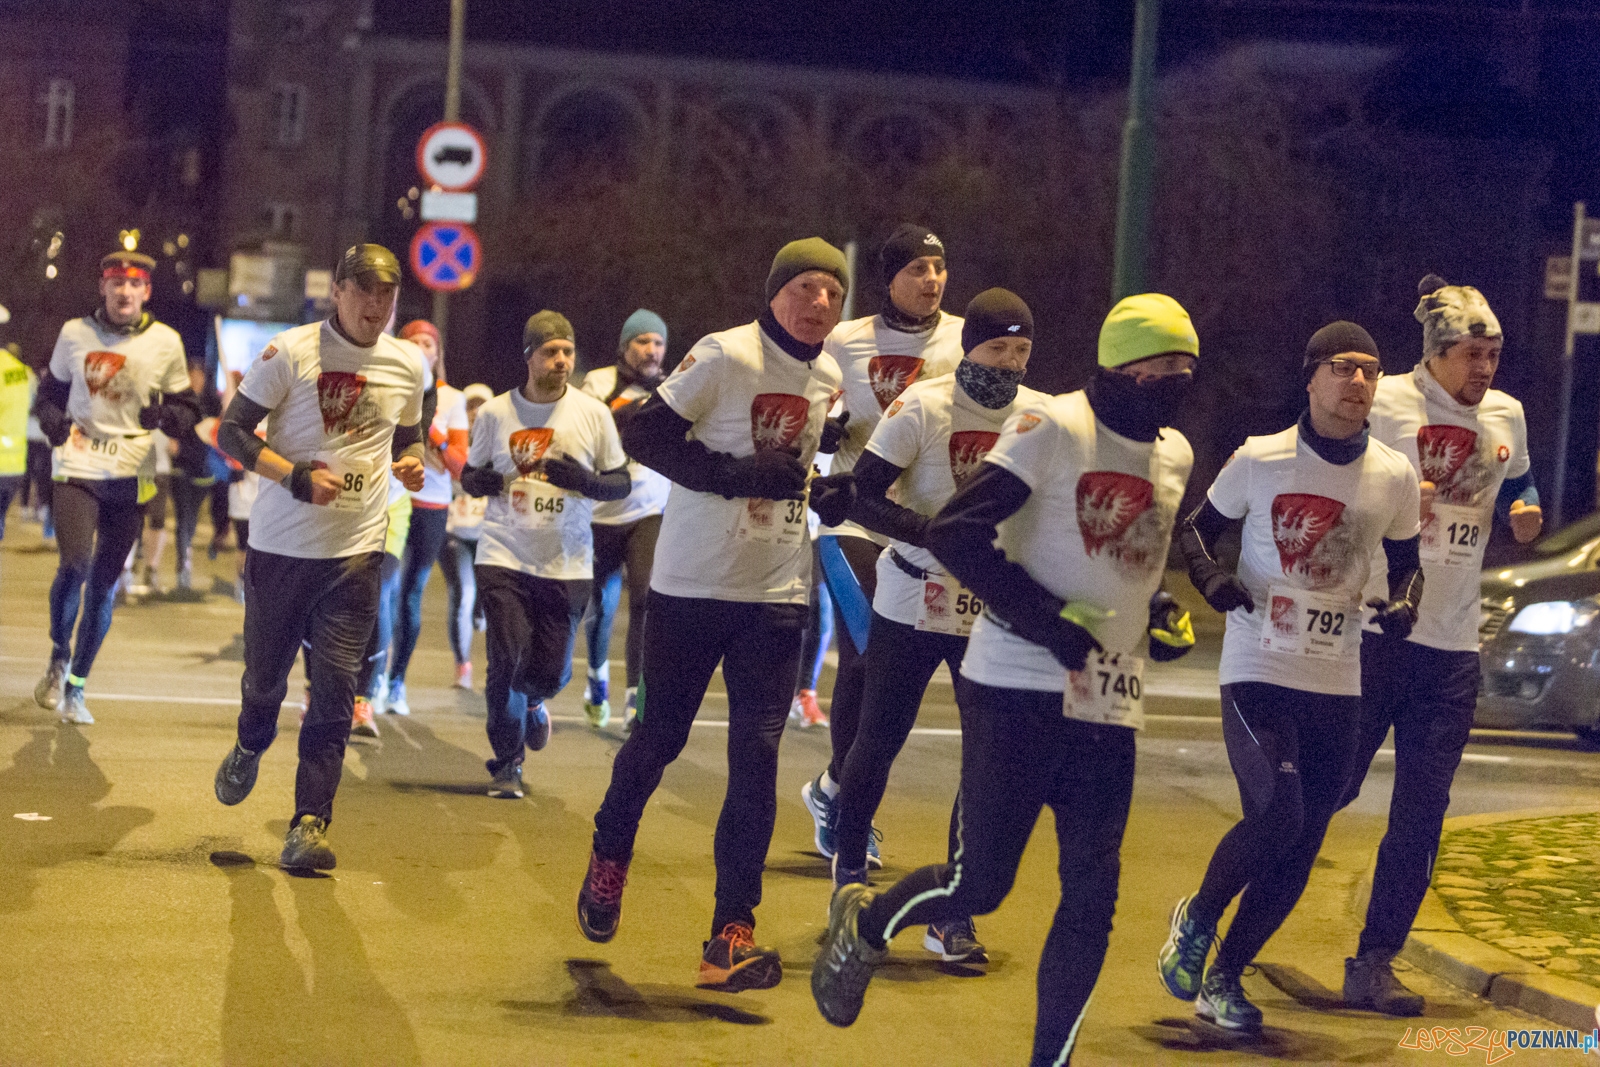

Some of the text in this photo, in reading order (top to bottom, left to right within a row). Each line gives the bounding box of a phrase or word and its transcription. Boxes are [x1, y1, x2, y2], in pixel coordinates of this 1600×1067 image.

[91, 438, 118, 455] 810
[534, 497, 565, 513] 645
[784, 500, 804, 524] 32
[1447, 522, 1480, 547] 128
[955, 593, 985, 616] 56
[1306, 608, 1345, 636] 792
[1097, 670, 1140, 700] 740
